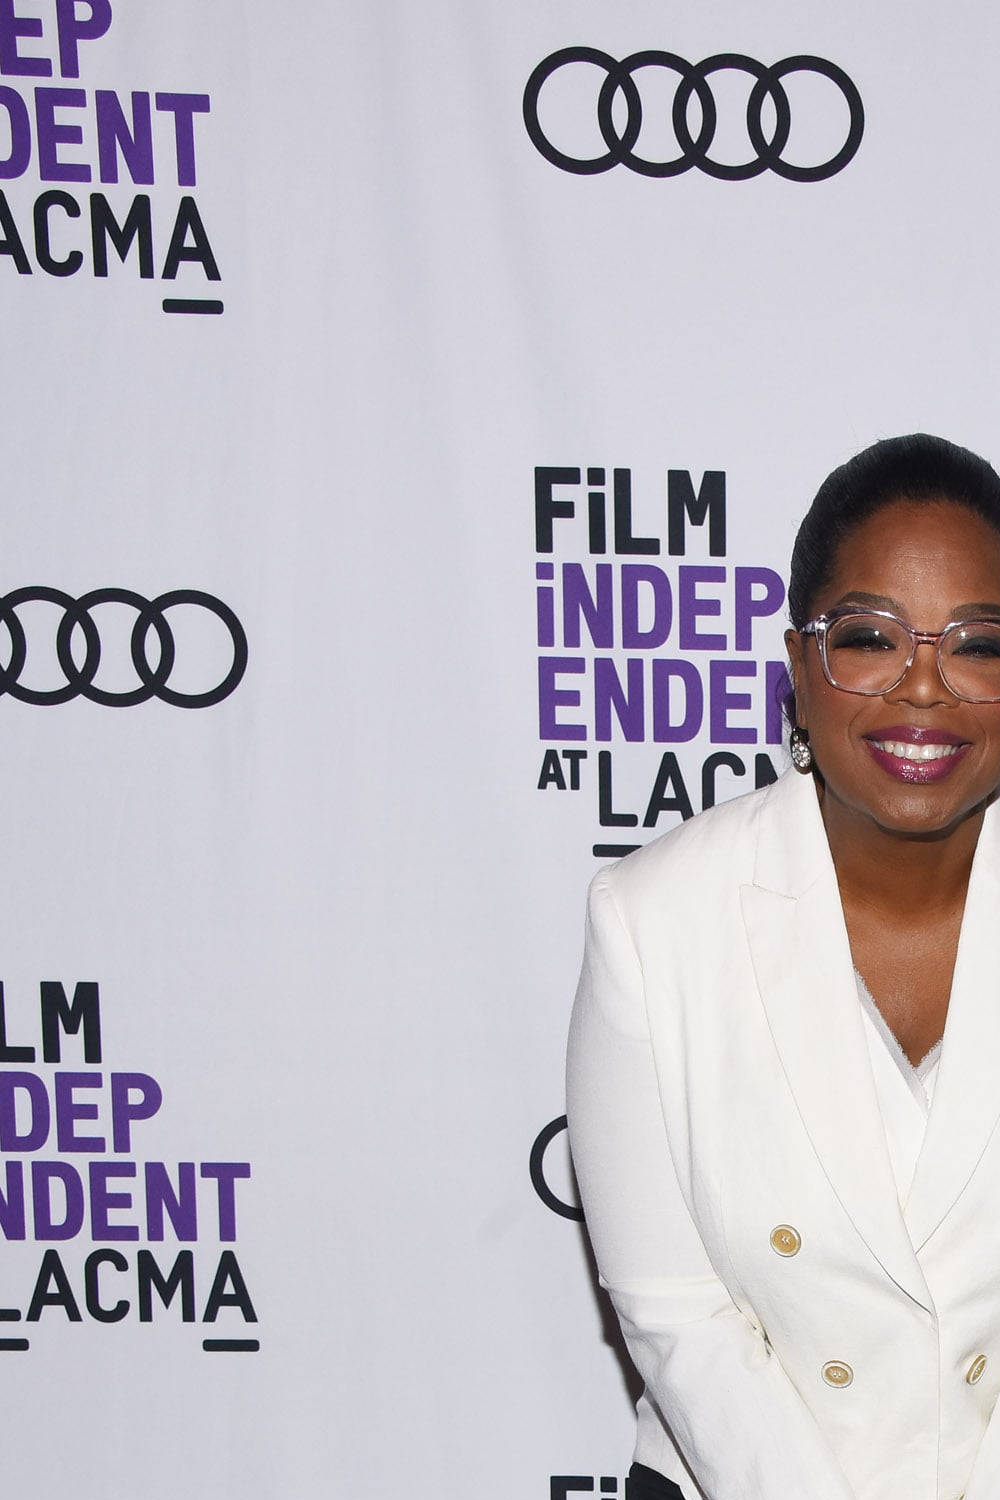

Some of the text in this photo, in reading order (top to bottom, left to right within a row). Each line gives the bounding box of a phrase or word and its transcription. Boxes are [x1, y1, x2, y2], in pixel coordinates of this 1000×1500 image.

[537, 749, 778, 828] AT LAC
[0, 1248, 259, 1323] ACMA
